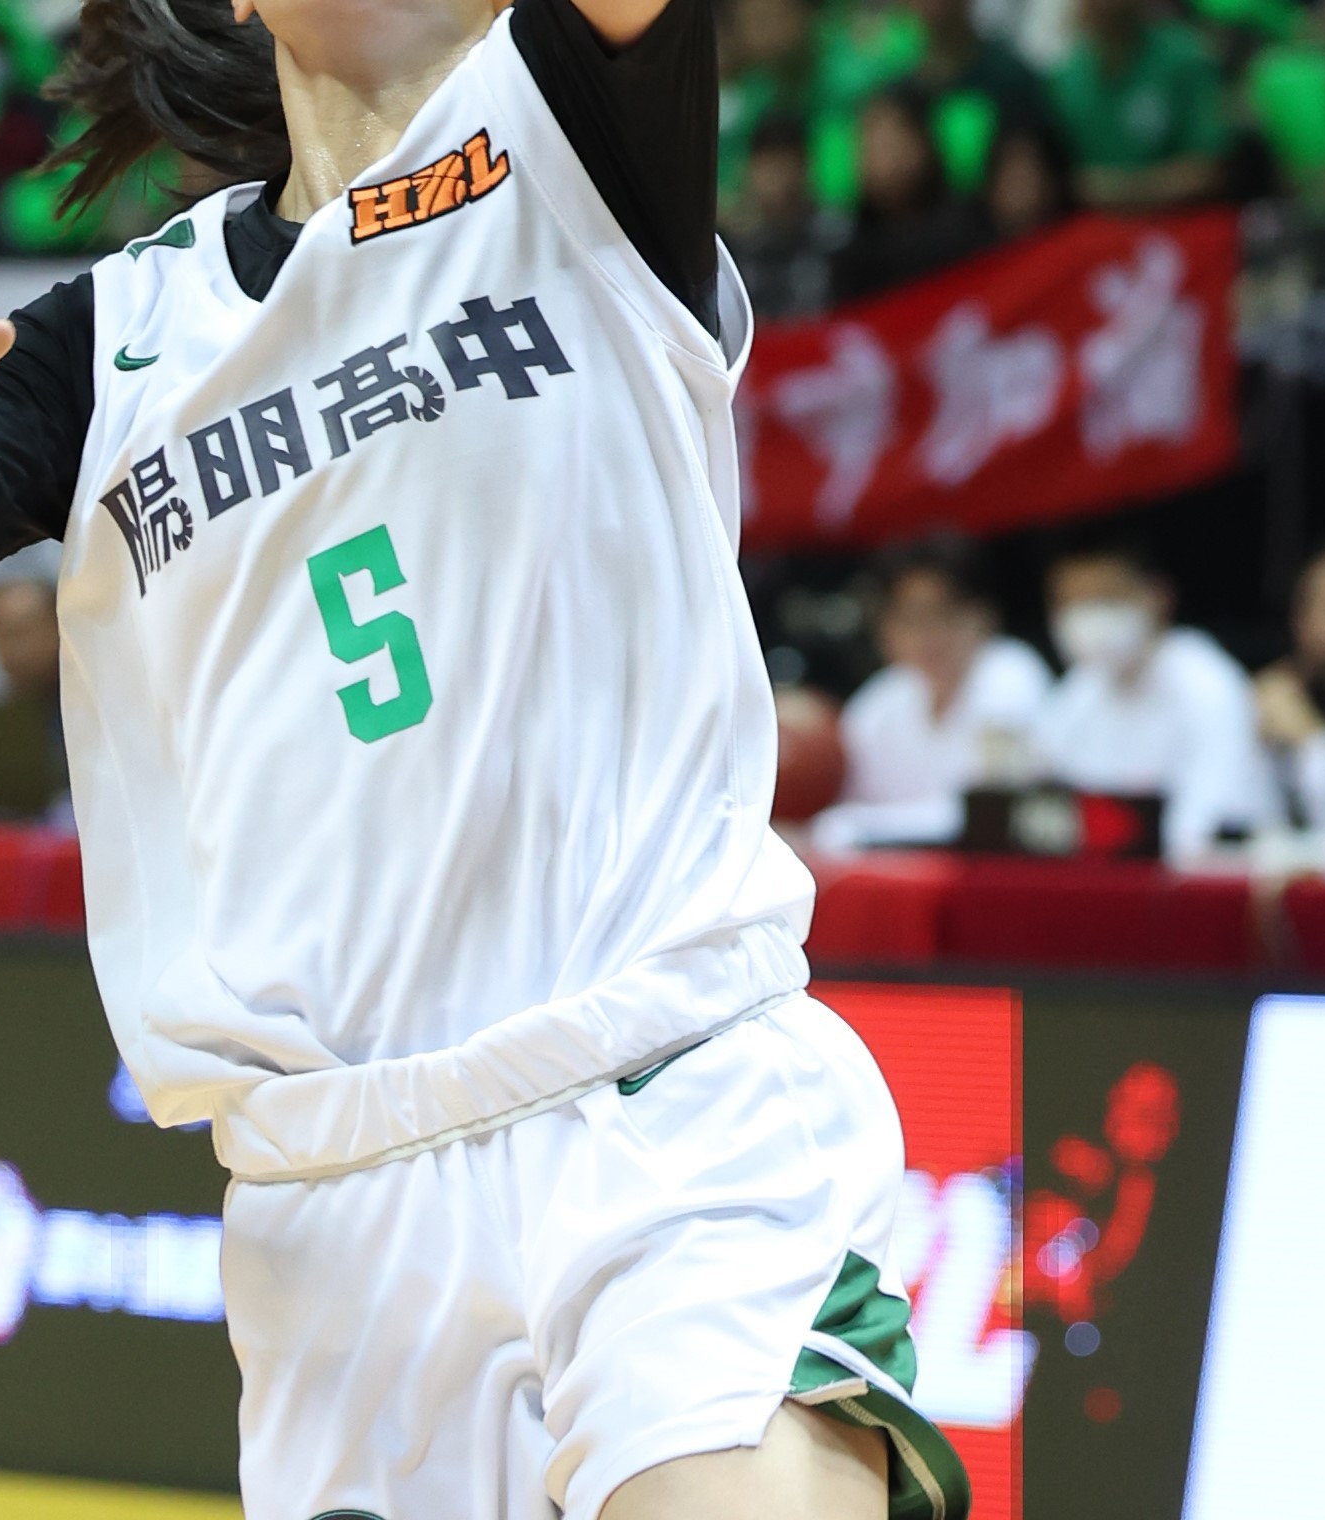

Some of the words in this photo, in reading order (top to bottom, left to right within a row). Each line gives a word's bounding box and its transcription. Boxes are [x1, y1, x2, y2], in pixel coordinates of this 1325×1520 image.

[99, 295, 576, 599] 陽明高中
[306, 523, 434, 744] 5
